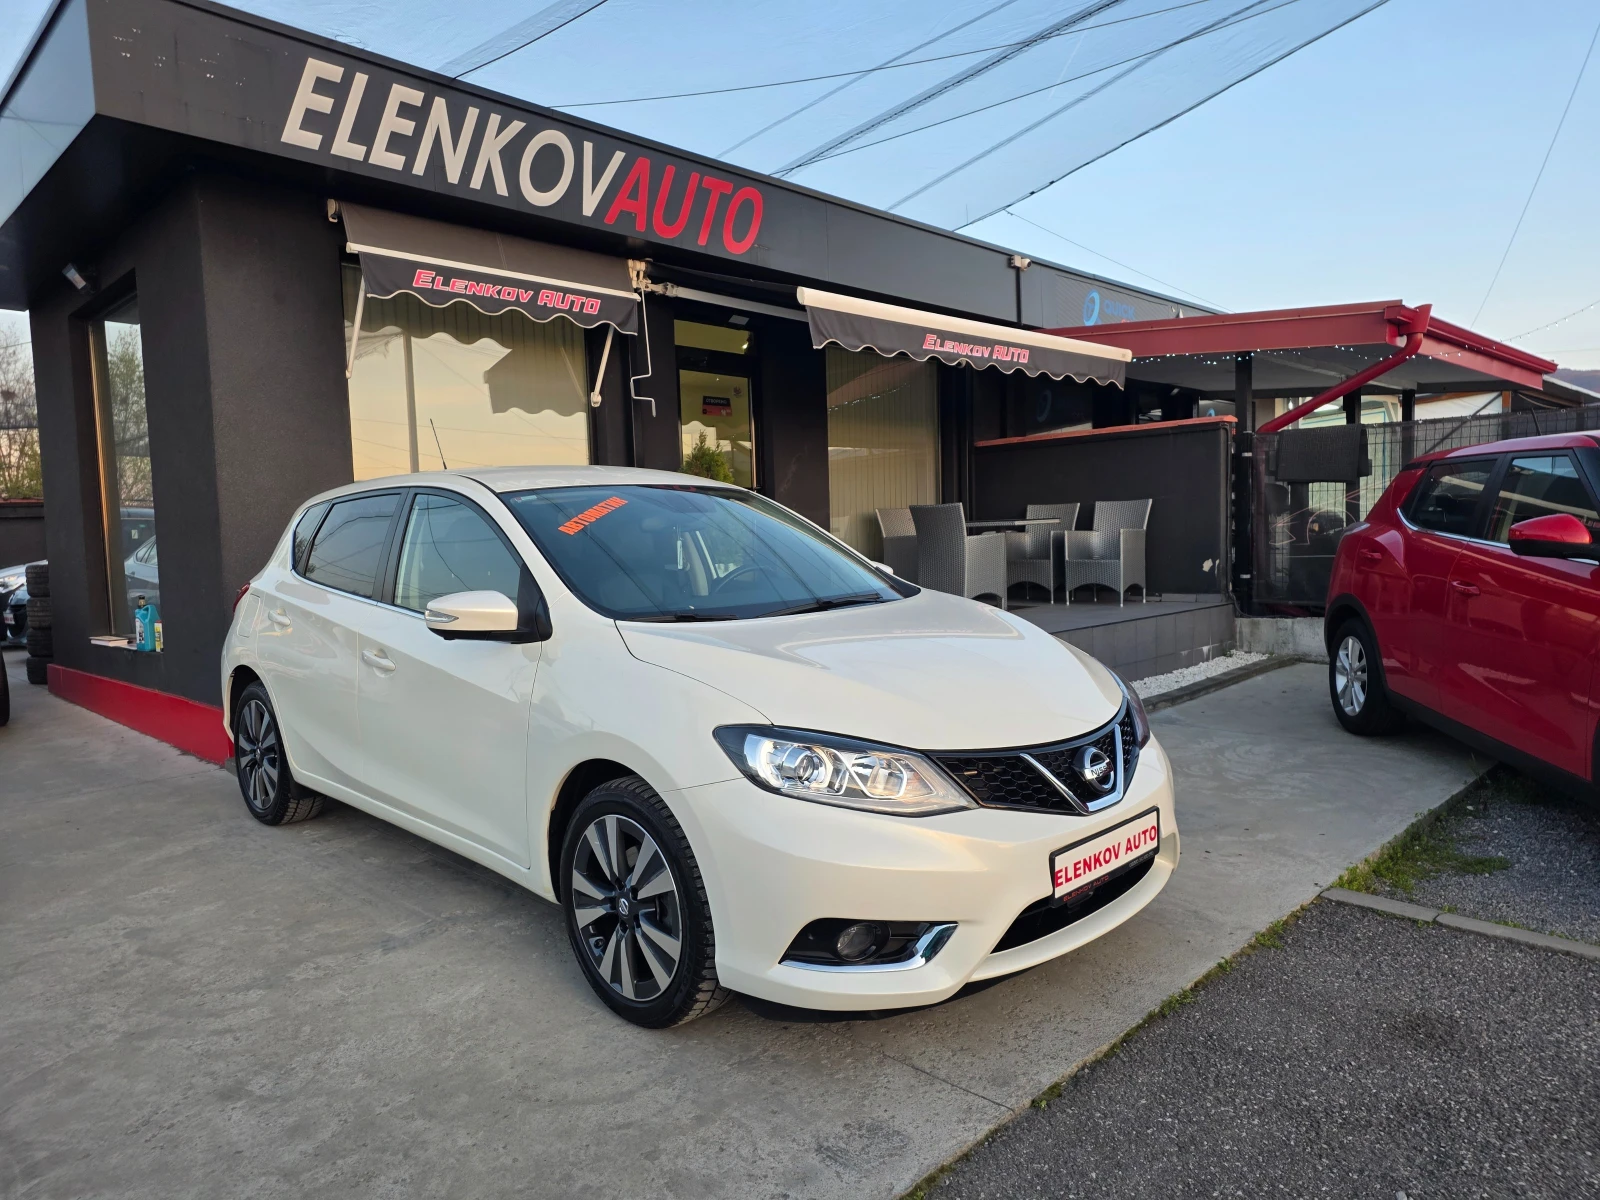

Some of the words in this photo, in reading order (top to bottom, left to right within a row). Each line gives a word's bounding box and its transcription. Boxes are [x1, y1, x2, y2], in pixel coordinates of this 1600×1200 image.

[412, 269, 534, 303] ELENKOV
[538, 289, 601, 315] AUTO
[1103, 299, 1135, 320] QUICK
[922, 333, 991, 358] ELENKOV
[992, 344, 1029, 364] AUTO
[557, 496, 629, 536] АВТОМАТИК
[1054, 842, 1122, 888] ELENKOV
[1125, 825, 1157, 855] AUTO
[1063, 884, 1092, 902] ELENKOV
[1093, 875, 1109, 887] AUTO
